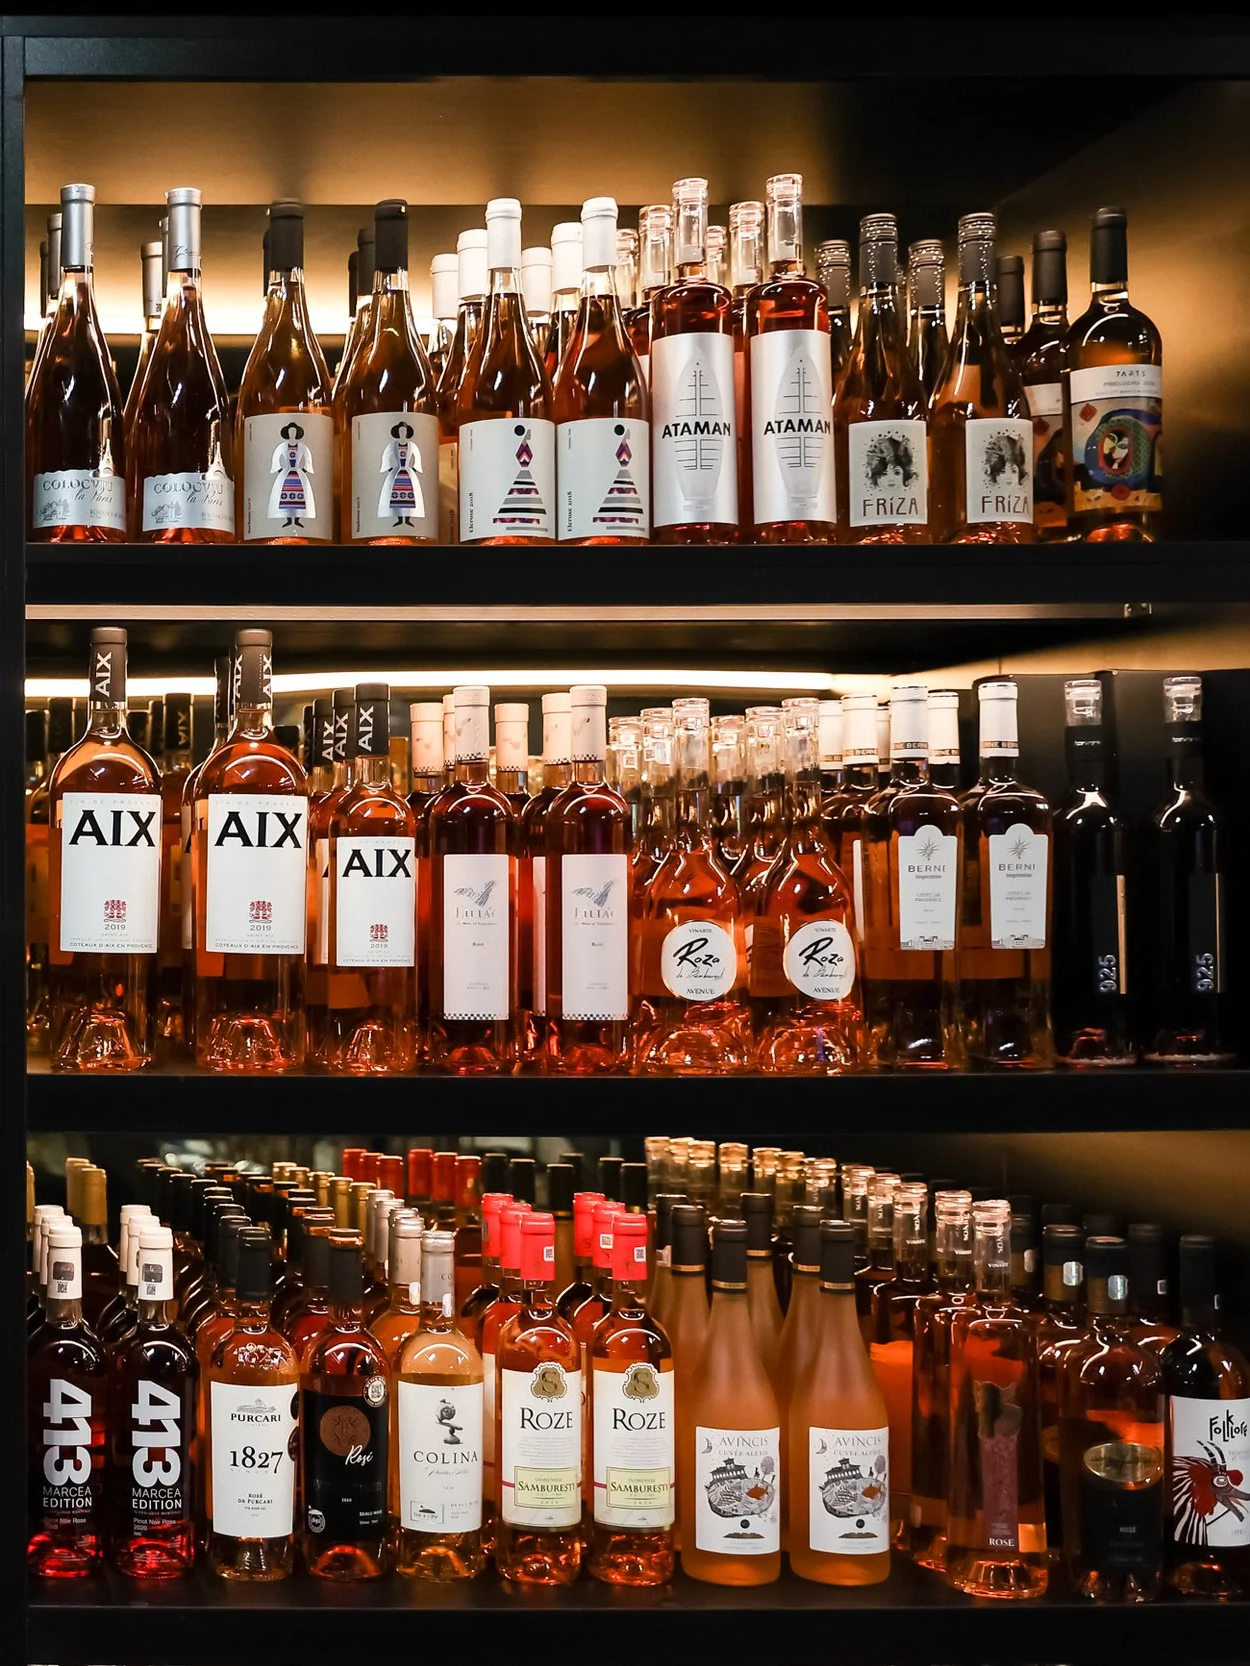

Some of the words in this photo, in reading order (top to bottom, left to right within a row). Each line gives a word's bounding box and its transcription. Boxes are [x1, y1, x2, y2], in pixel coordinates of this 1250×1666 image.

[662, 421, 731, 439] ATAMAN
[763, 418, 831, 436] ATAMAN
[95, 652, 112, 698] AIX
[334, 712, 349, 757] AIX
[358, 705, 375, 752] AIX
[322, 720, 335, 762] AIX
[68, 809, 156, 847] AIX
[214, 810, 303, 849] AIX
[342, 848, 412, 878] AIX
[672, 937, 721, 968] Roza
[798, 936, 844, 967] Roza
[1099, 954, 1117, 993] 925
[1196, 952, 1215, 993] 925
[686, 987, 715, 995] AVENUE
[230, 1413, 282, 1423] PURCARI
[519, 1407, 574, 1430] ROZE
[612, 1407, 667, 1430] ROZE
[43, 1378, 92, 1486] 413
[131, 1380, 181, 1488] 413
[719, 1435, 769, 1449] AVINCIS
[230, 1446, 284, 1474] 1827
[345, 1444, 373, 1467] Rosé
[413, 1450, 478, 1465] COLINA
[42, 1486, 92, 1497] MARCEA
[43, 1497, 93, 1509] EDITION
[132, 1487, 182, 1499] MARCEA
[132, 1498, 182, 1510] EDITION
[133, 1517, 148, 1525] Pinot
[989, 1537, 1015, 1548] ROSE
